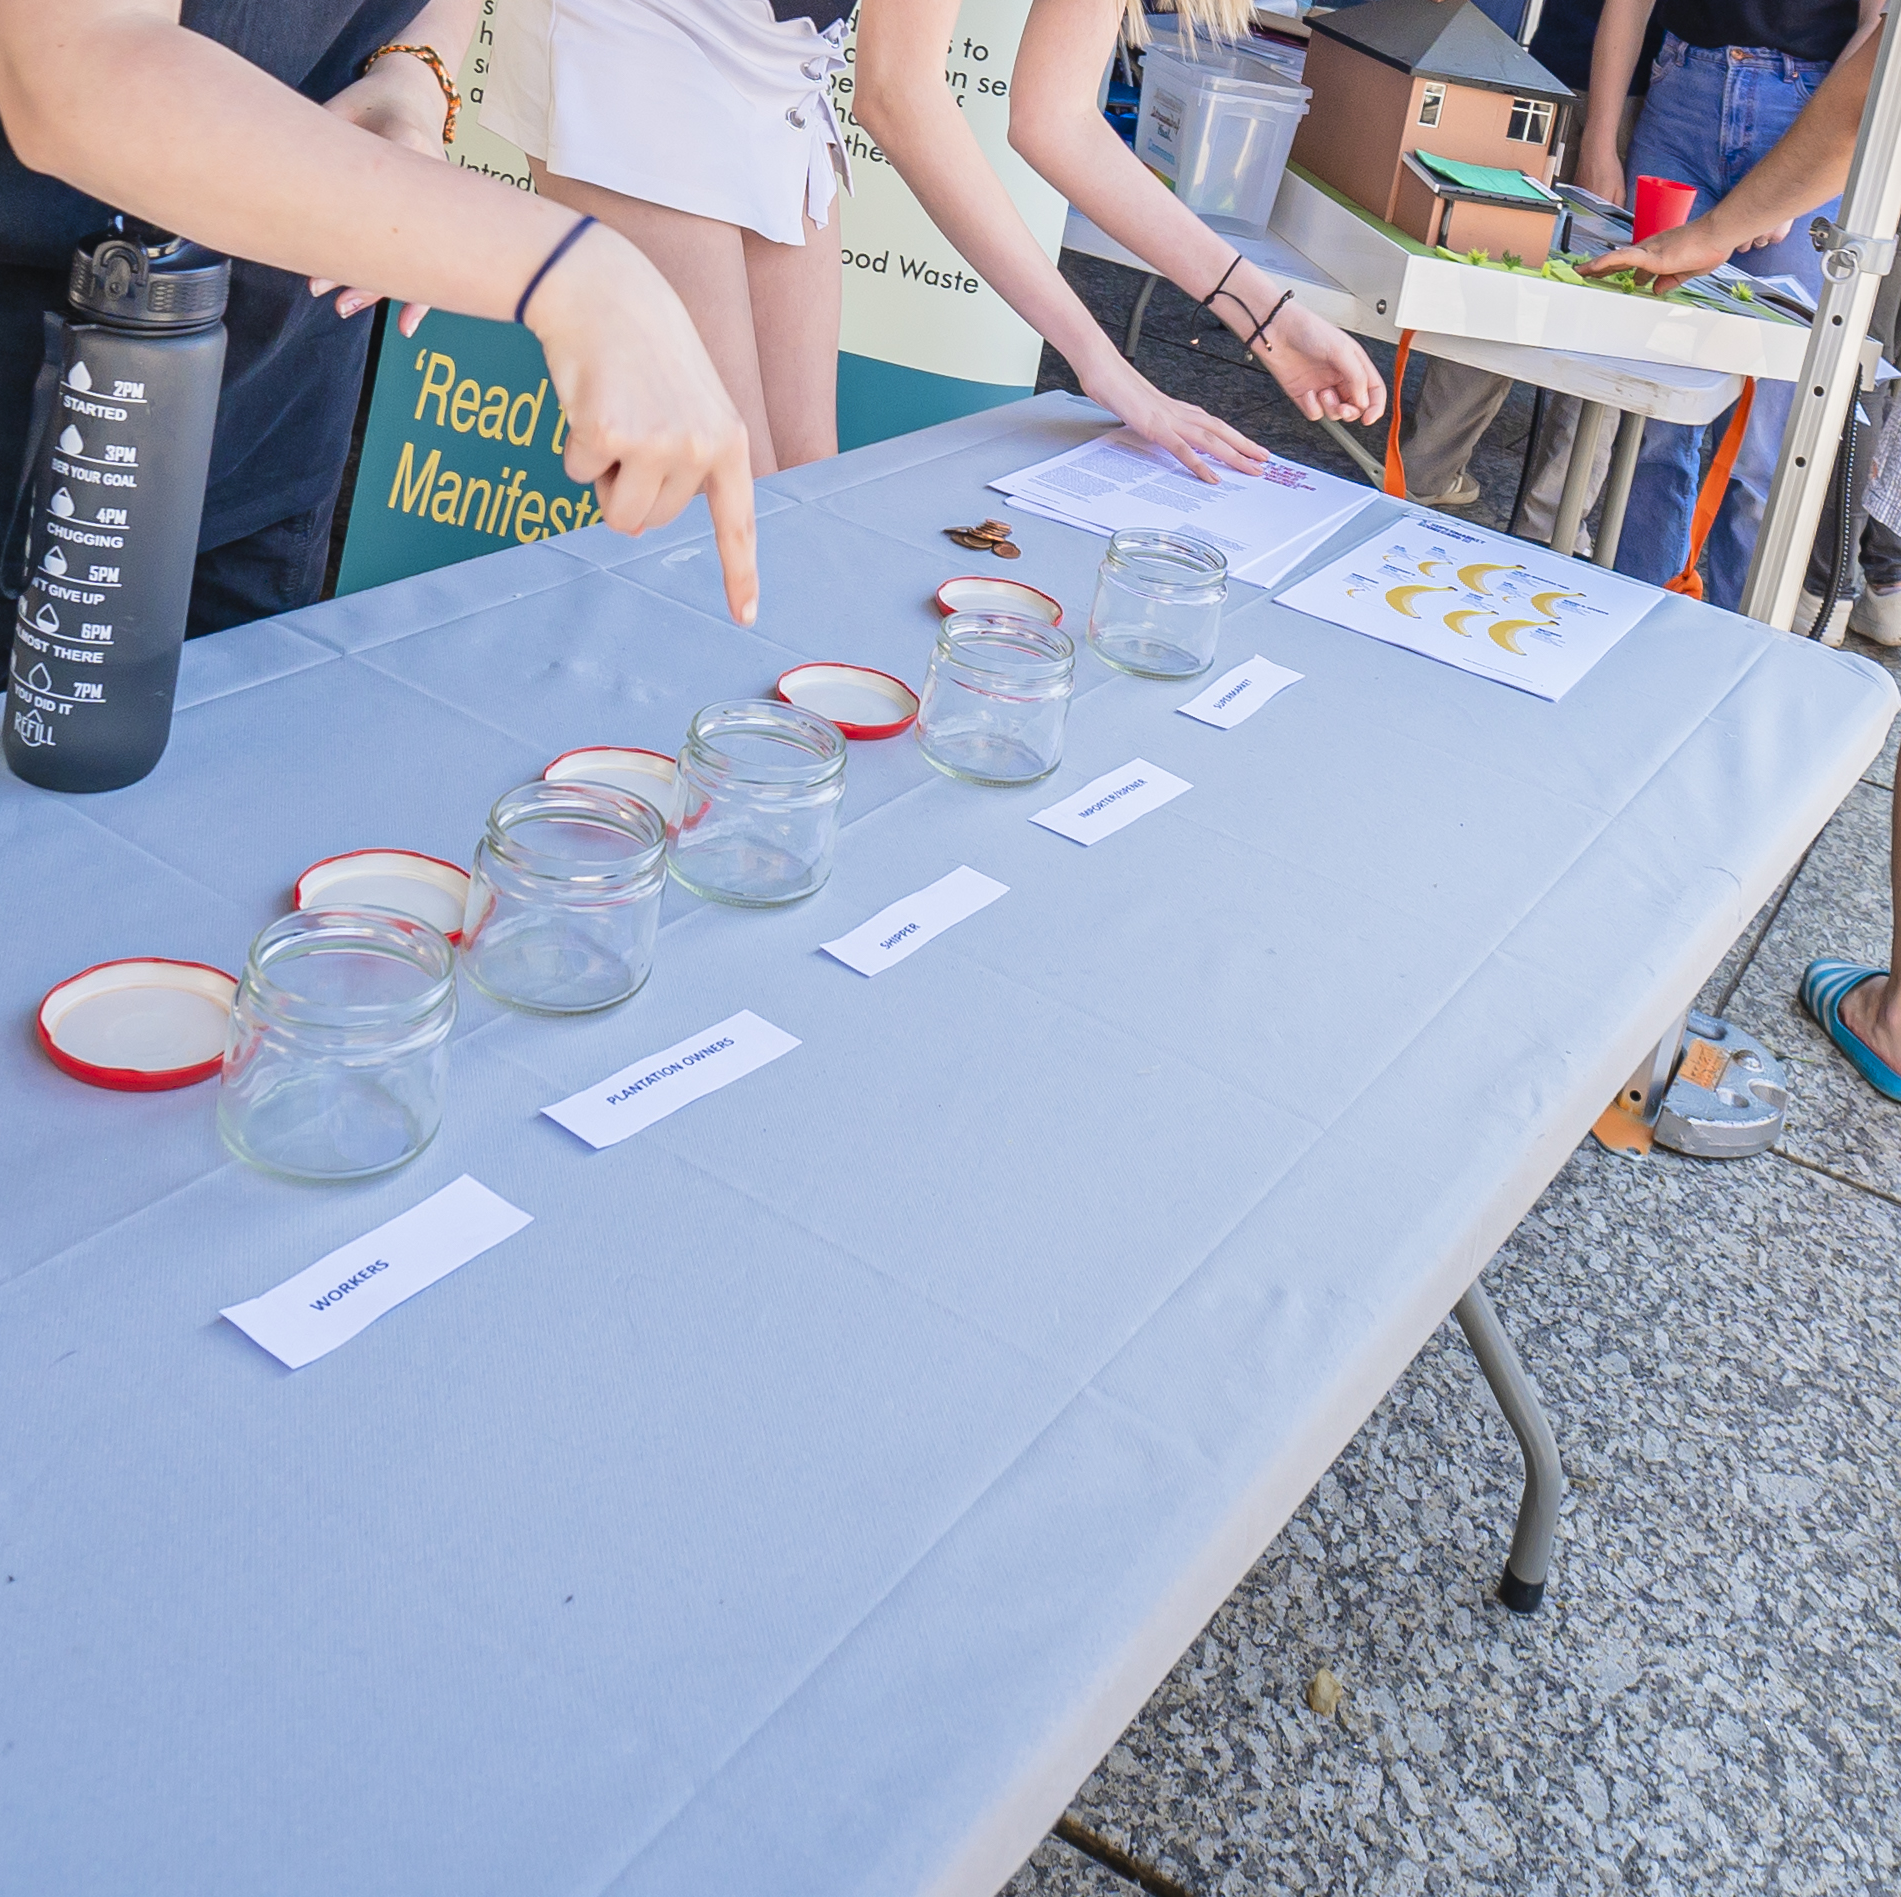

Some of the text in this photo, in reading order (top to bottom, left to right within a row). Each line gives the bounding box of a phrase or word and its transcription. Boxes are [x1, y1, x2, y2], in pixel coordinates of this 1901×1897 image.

[964, 37, 989, 62] to
[460, 154, 539, 195] Introd
[841, 249, 980, 295] ood Waste
[112, 380, 145, 399] 2PM
[63, 395, 128, 422] STARTED
[104, 444, 137, 463] 3PM
[71, 464, 101, 485] YOUR
[102, 472, 138, 488] GOAL
[96, 508, 128, 525] 4PM
[46, 522, 124, 549] CHUGGING
[88, 565, 120, 583] 5PM
[49, 586, 81, 603] GIVE
[82, 592, 106, 606] UP
[80, 623, 113, 641] 6PM
[52, 645, 105, 664] THERE
[14, 683, 74, 716] YOU DID IT
[73, 682, 104, 699] 7PM
[14, 710, 57, 746] REFILL
[878, 921, 921, 951] SHIPPER
[605, 1036, 736, 1107] PLANTATION OWNERS
[309, 1257, 391, 1312] WORKERS
